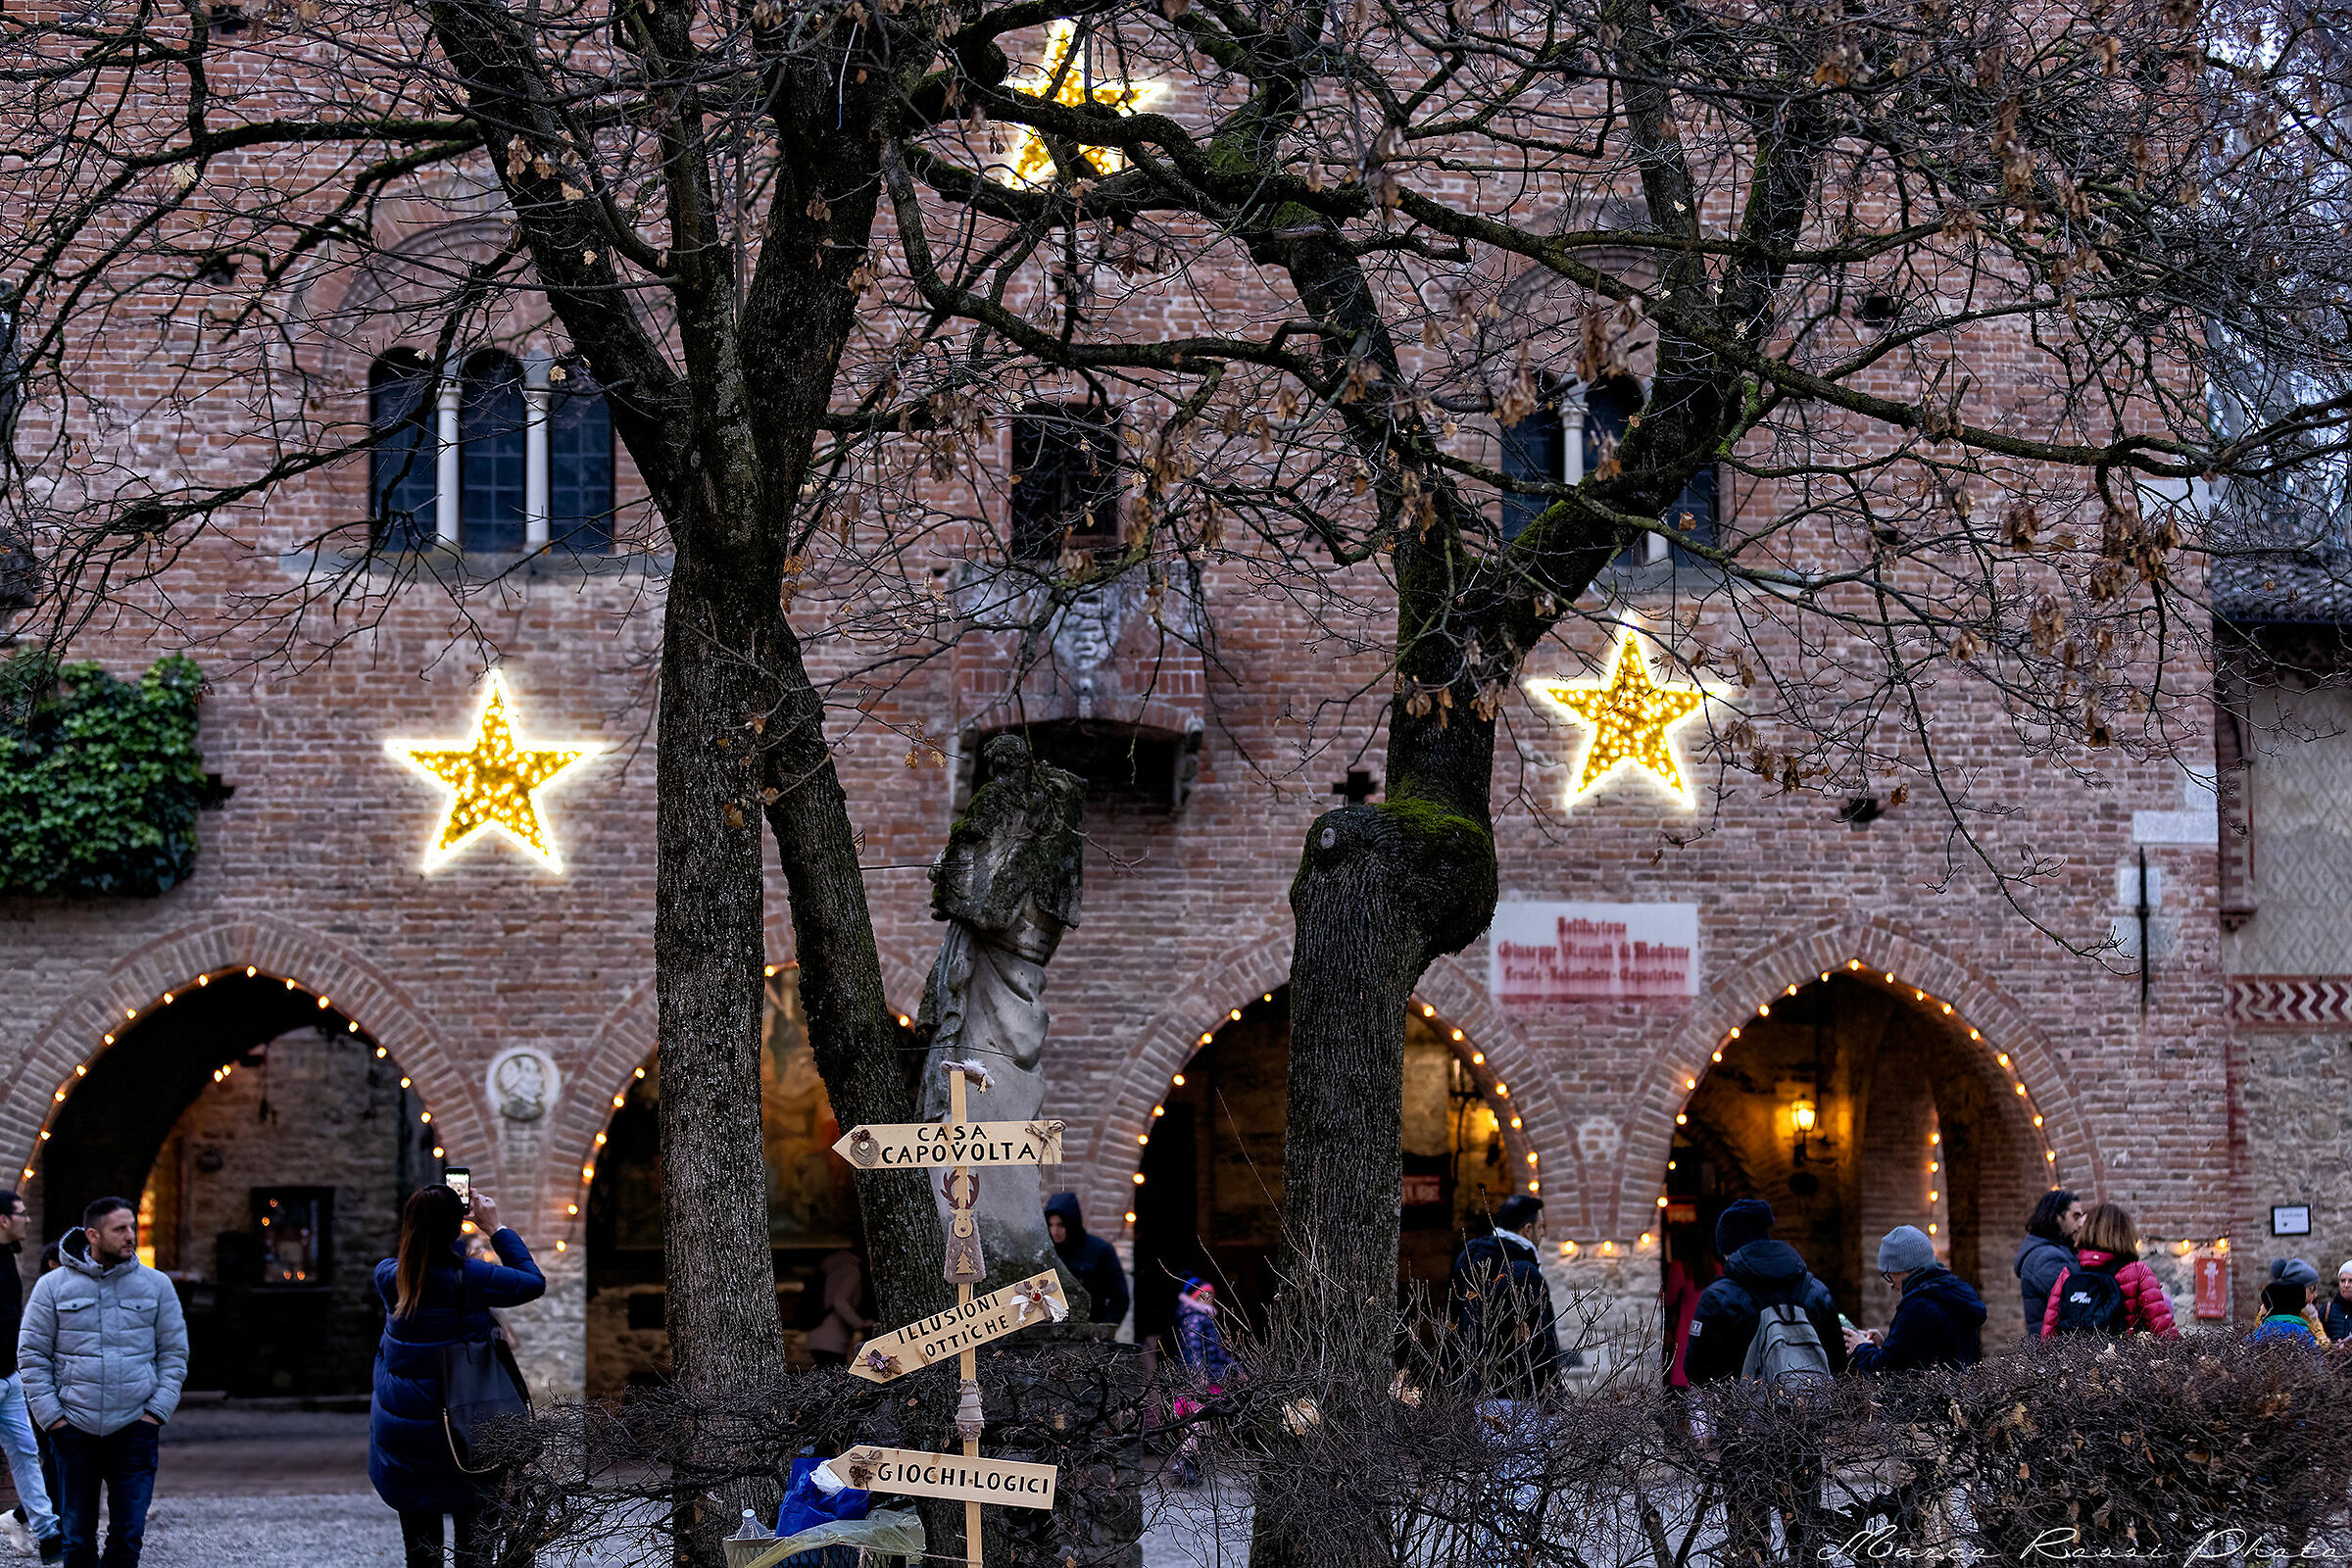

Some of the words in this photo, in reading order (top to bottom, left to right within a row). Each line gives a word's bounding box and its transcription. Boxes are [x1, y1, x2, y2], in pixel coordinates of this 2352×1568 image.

[917, 1125, 988, 1142] CASA
[881, 1142, 1037, 1164] CAPOVOLTA
[897, 1294, 1000, 1345] ILLUSIONI
[925, 1315, 1009, 1357] OTTICHE
[877, 1462, 965, 1488] GIOCHI
[973, 1470, 1049, 1494] LOGICI
